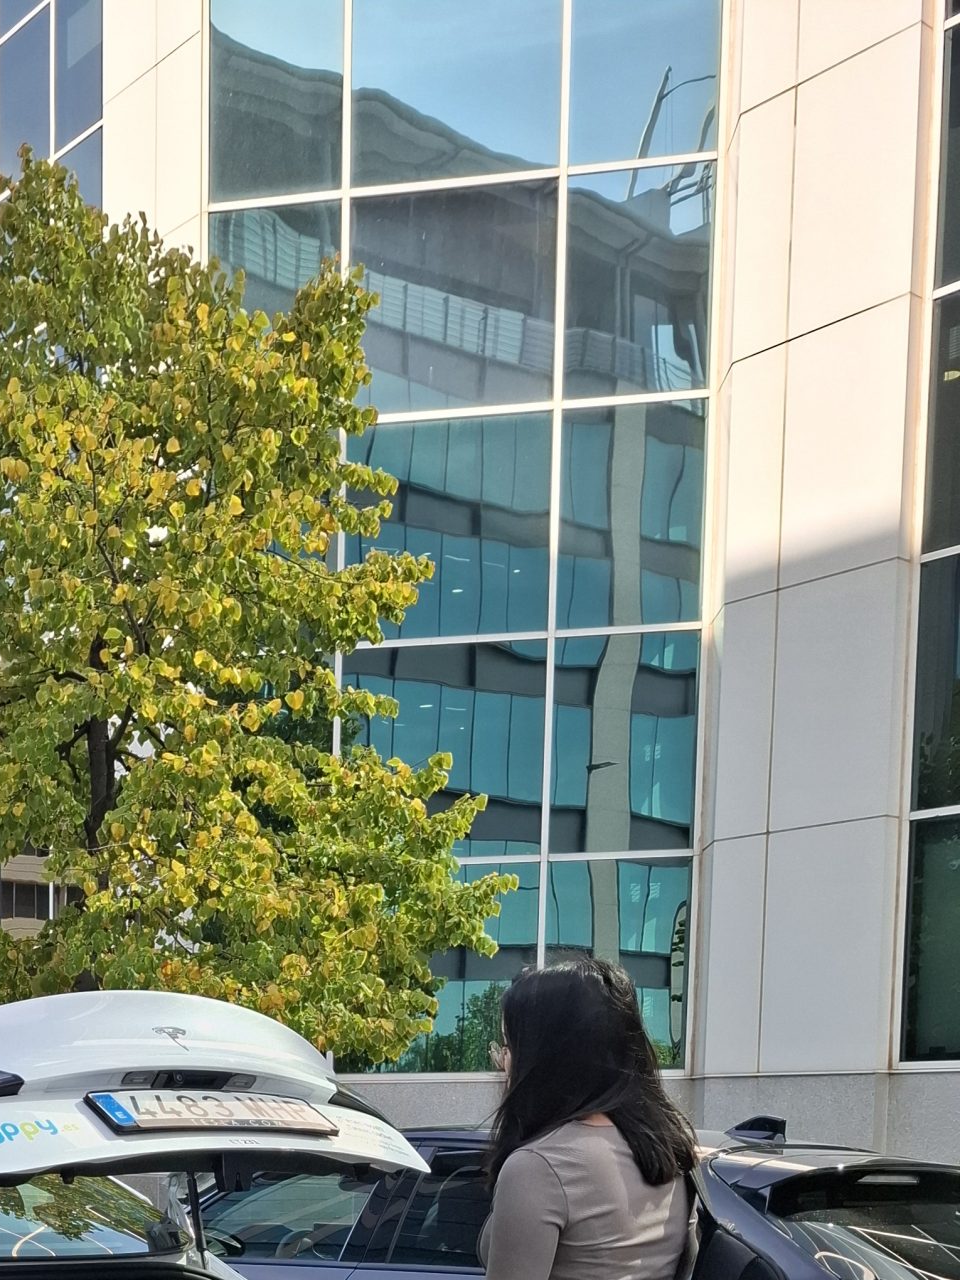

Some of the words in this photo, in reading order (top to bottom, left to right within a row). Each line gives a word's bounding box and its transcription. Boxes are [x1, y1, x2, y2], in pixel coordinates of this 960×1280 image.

[114, 1111, 128, 1119] E
[129, 1095, 235, 1118] 4483
[233, 1096, 306, 1120] MHP
